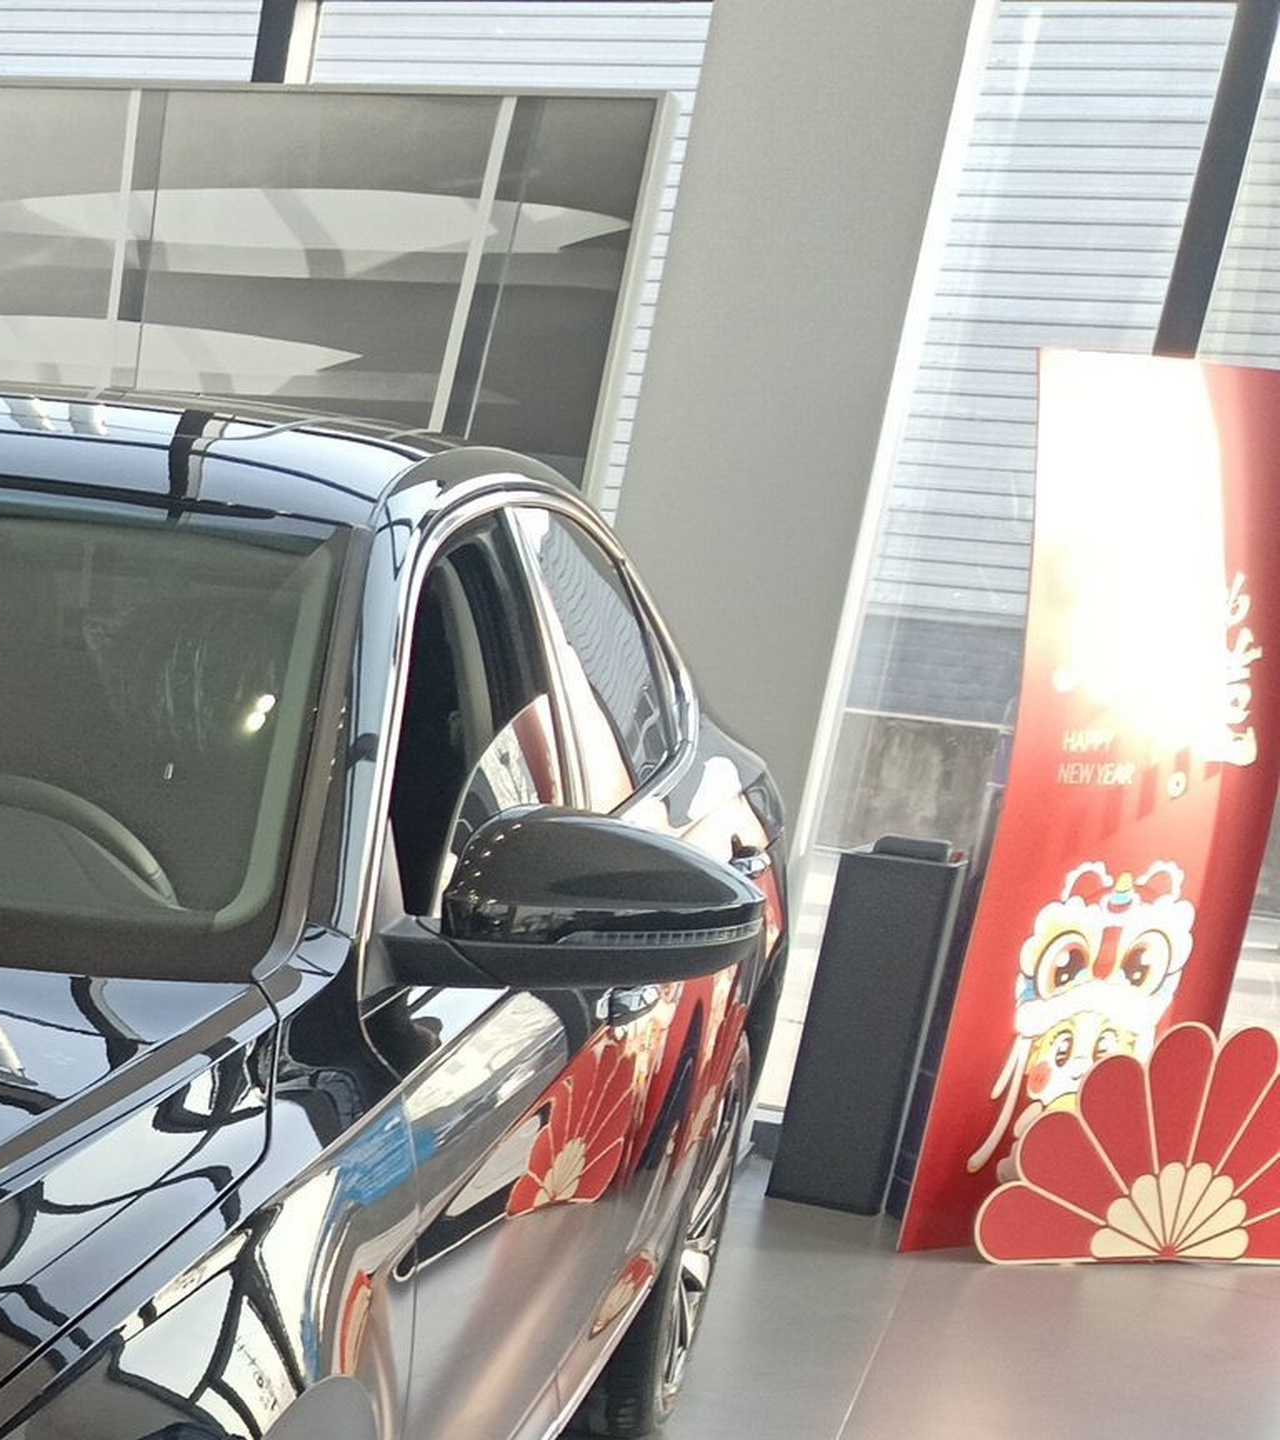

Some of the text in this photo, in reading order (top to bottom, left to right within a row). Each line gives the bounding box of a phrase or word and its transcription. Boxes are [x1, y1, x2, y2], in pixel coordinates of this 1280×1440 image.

[1063, 730, 1117, 752] HAPPY
[1057, 762, 1137, 785] NEW YEAR
